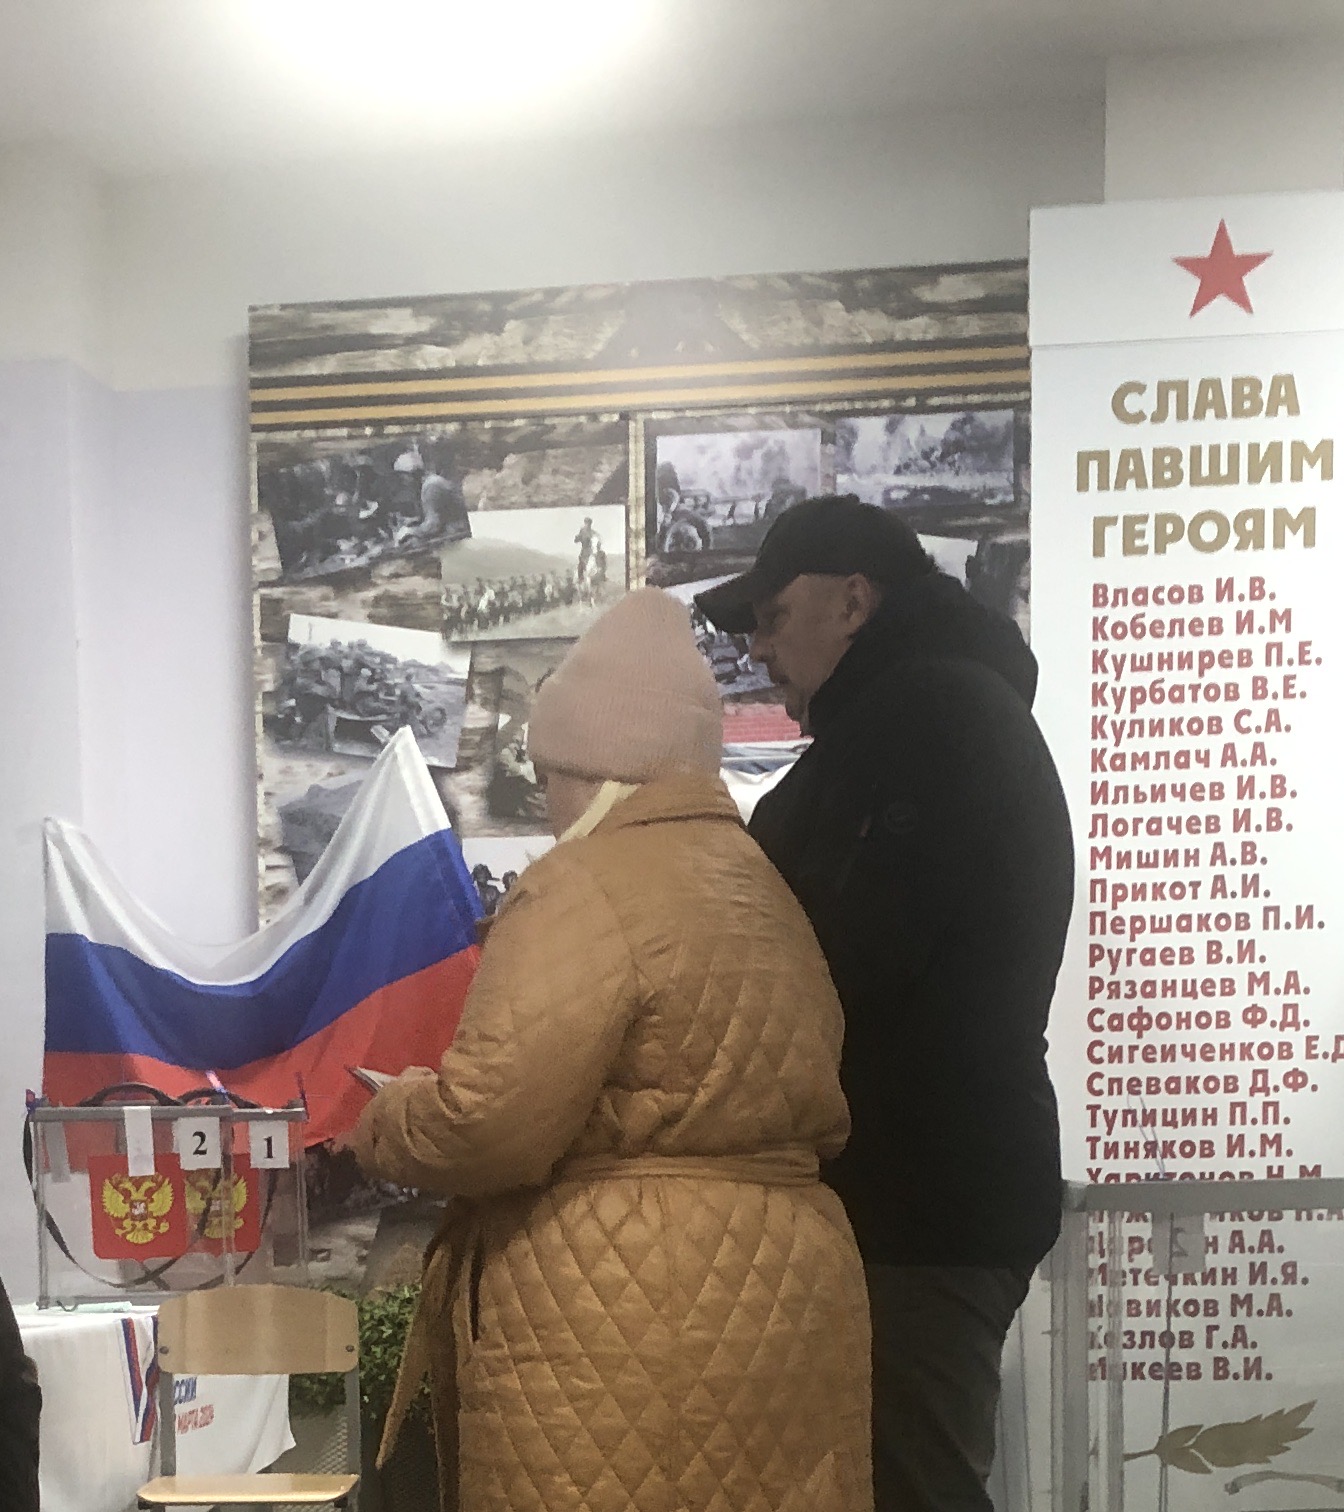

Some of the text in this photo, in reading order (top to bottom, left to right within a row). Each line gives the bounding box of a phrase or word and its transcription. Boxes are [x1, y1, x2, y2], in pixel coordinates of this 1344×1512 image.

[1111, 373, 1300, 425] СЛАВА
[1076, 439, 1333, 492] ПАВШИМ
[1092, 506, 1317, 558] ГЕРОЯМ
[1092, 576, 1276, 608] Власов И.В.
[1092, 613, 1224, 641] Кобелев
[1092, 640, 1322, 682] Кушнирев П.Е.
[1092, 674, 1307, 714] Курбатов В.Е.
[1091, 708, 1292, 747] Куликов С.А.
[1091, 741, 1277, 773] Камлач А.А.
[1090, 774, 1298, 805] Ильичев И.В.
[1088, 807, 1293, 839] Логачев И.В.
[1090, 841, 1268, 871] Мишин А.В.
[1089, 873, 1271, 910] Прикот А.И.
[1089, 904, 1325, 942] Першаков П.И.
[1089, 939, 1267, 975] Ругаев В.И.
[1088, 971, 1311, 1000] Рязанцев М.А.
[1087, 1003, 1311, 1039] Сафонов Ф.Д.
[1086, 1068, 1319, 1097] Спеваков Д.Ф.
[1086, 1101, 1291, 1136] Тупицин П.П.
[191, 1131, 275, 1160] 2 1
[1086, 1133, 1293, 1160] Тиняков И.М.
[1228, 1229, 1285, 1254] А.А.
[1249, 1261, 1309, 1286] И.Я.
[1230, 1292, 1293, 1317] М.А.
[1205, 1325, 1258, 1349] Г.А.
[1213, 1356, 1273, 1381] В.И.
